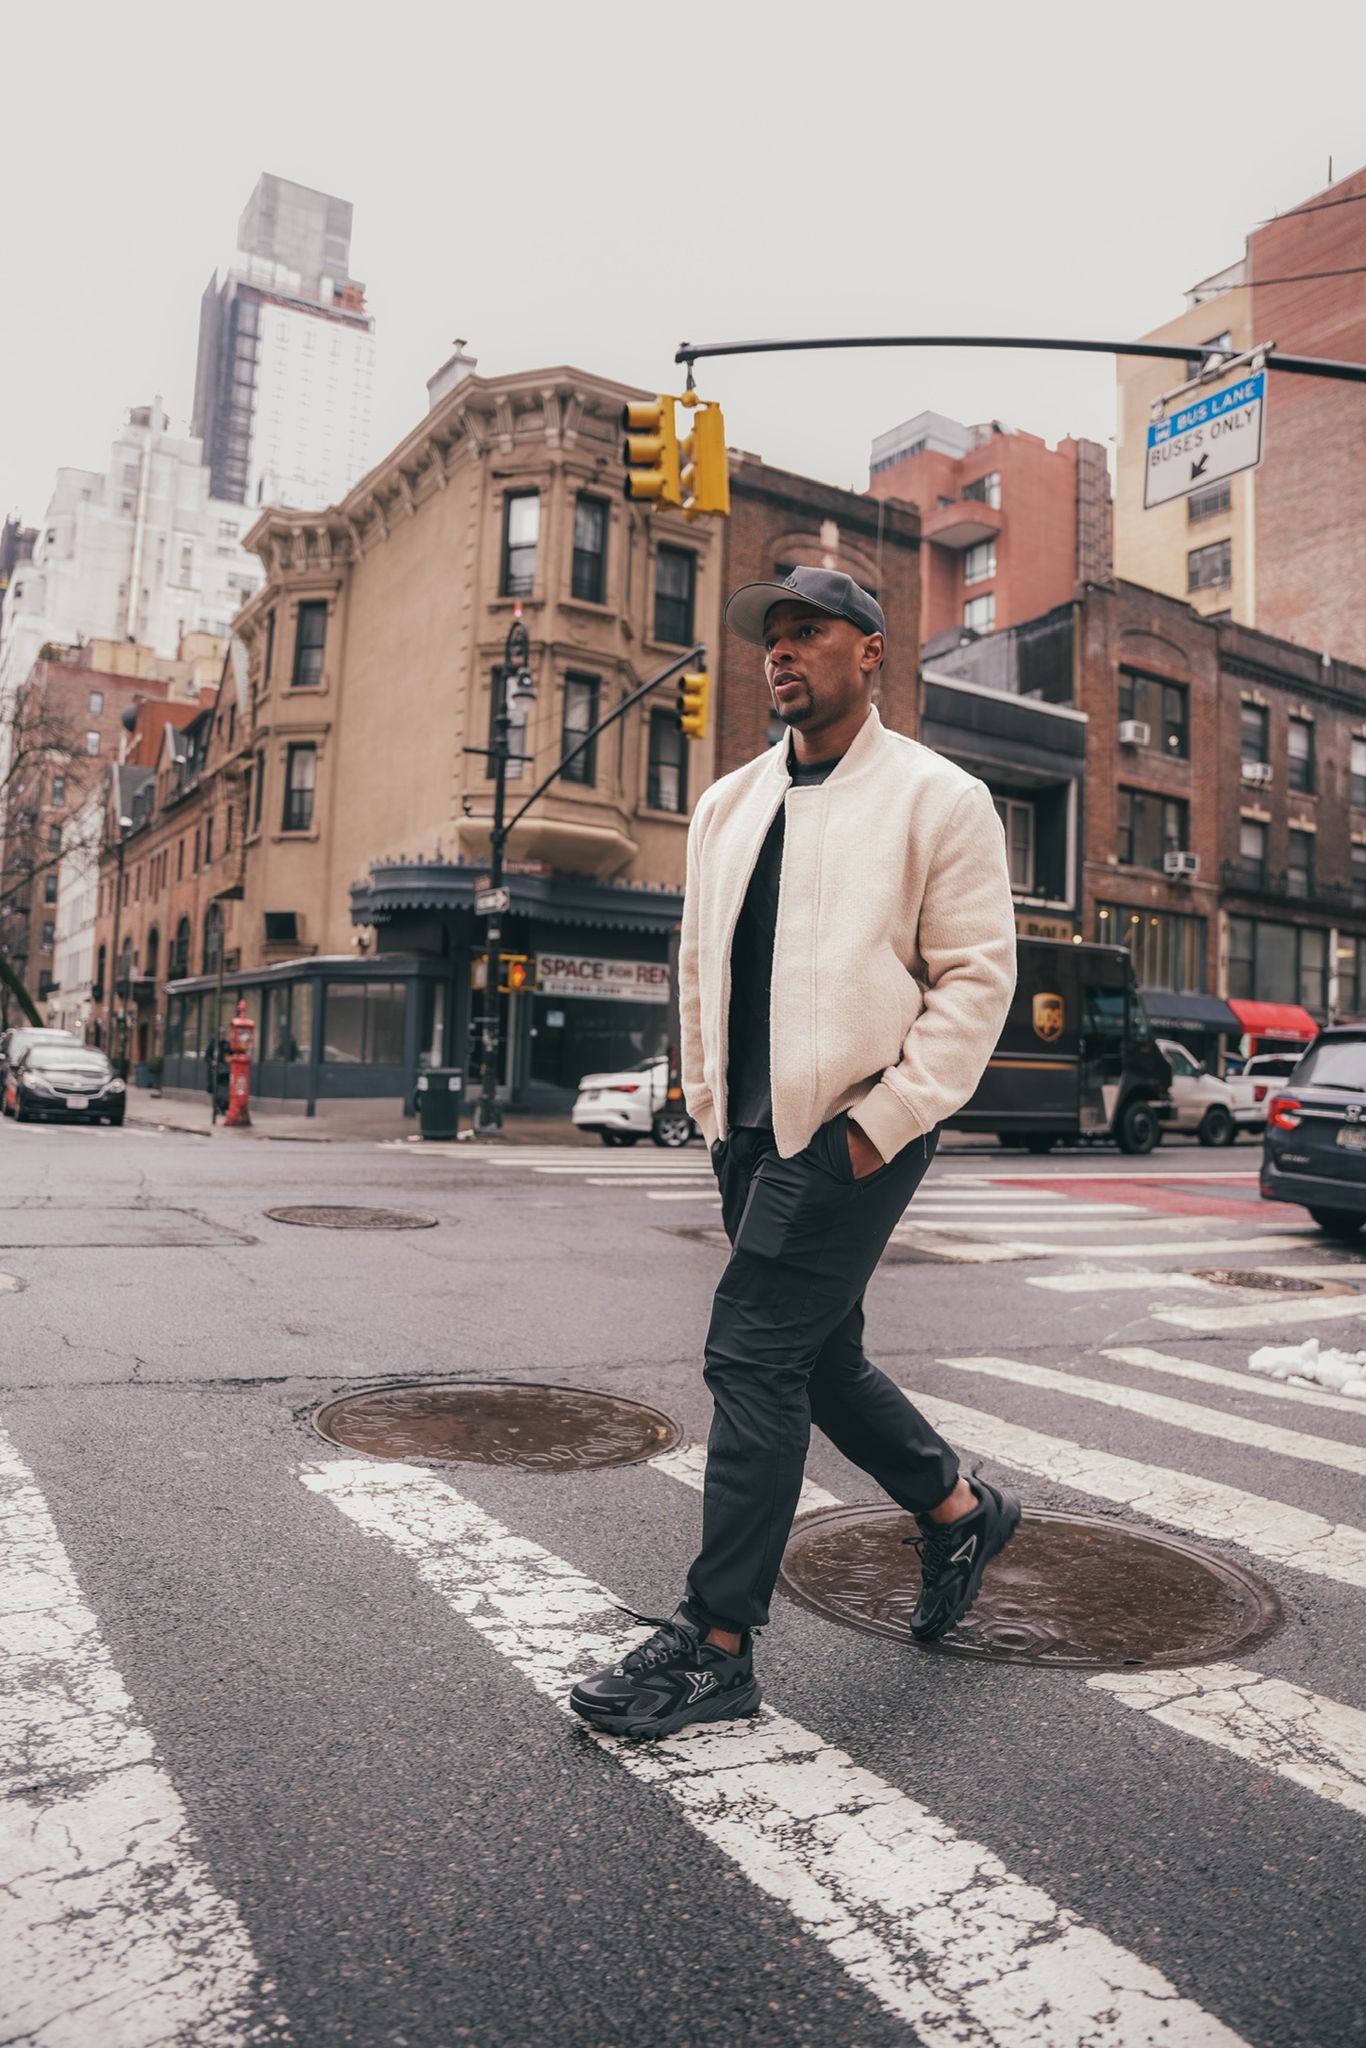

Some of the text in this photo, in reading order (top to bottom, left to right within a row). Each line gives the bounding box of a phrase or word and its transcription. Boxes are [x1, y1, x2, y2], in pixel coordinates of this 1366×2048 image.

[1176, 382, 1256, 430] BUS LANE
[1151, 407, 1256, 467] BUSES ONLY
[541, 957, 603, 979] SPACE
[607, 965, 633, 978] FOR
